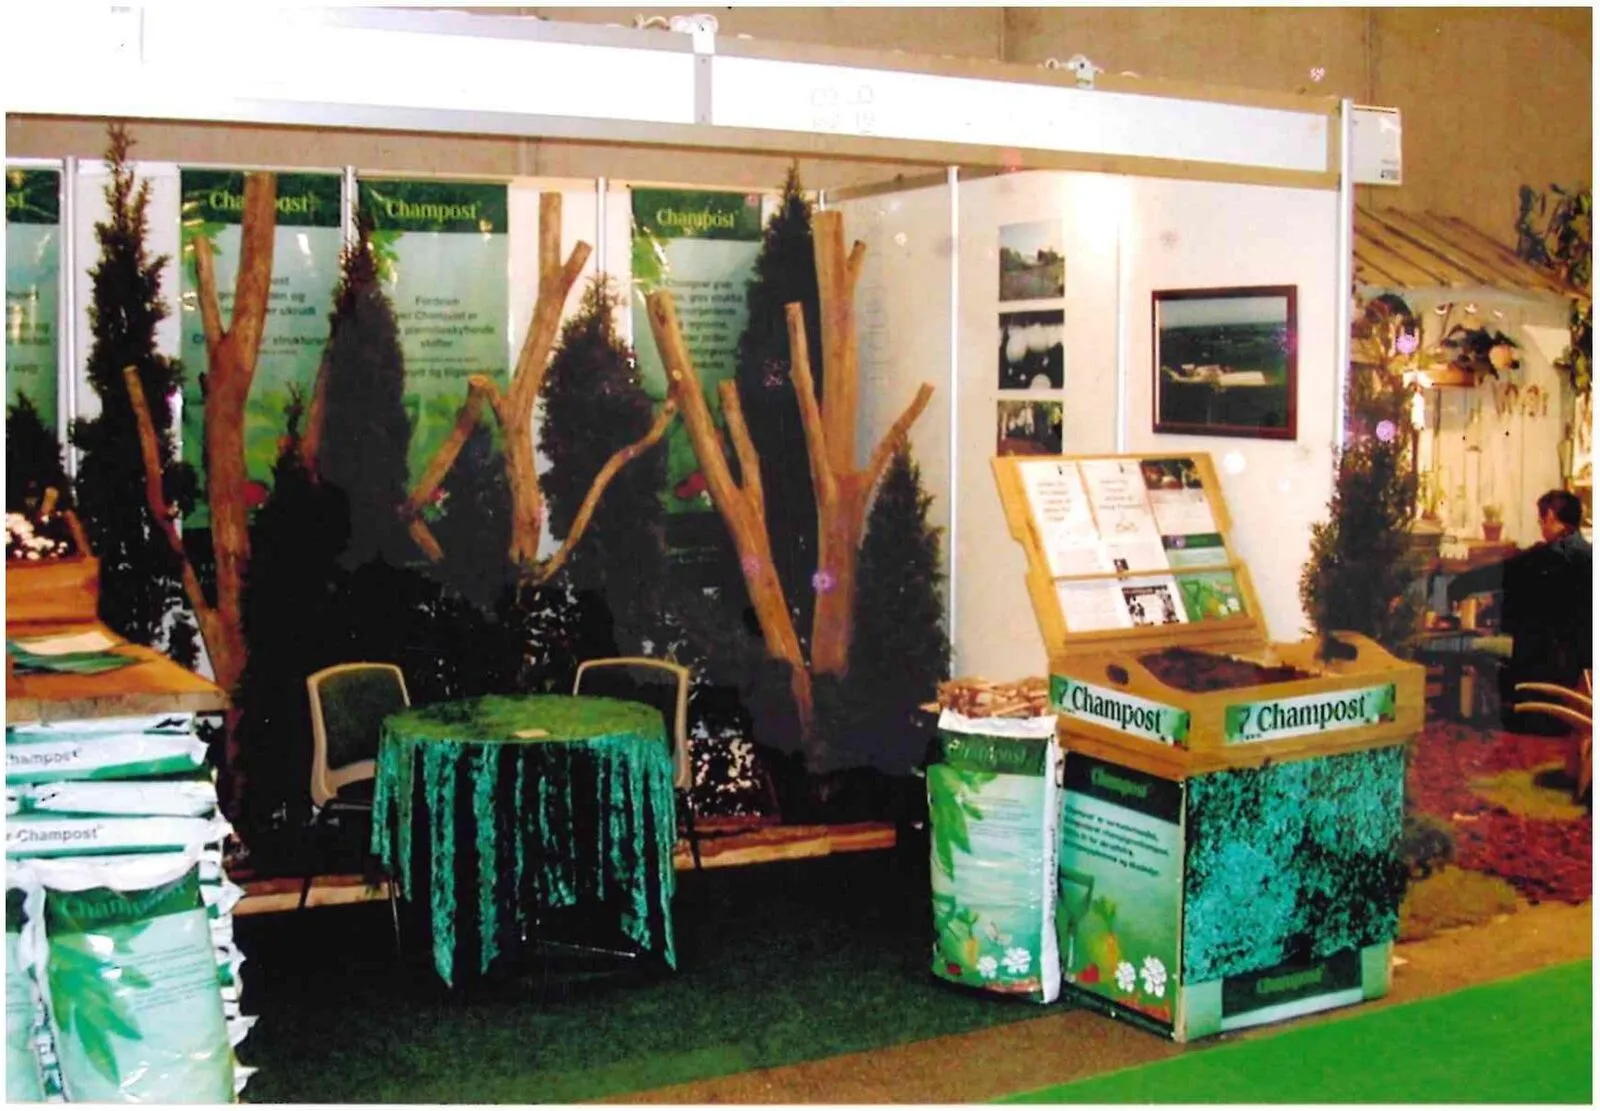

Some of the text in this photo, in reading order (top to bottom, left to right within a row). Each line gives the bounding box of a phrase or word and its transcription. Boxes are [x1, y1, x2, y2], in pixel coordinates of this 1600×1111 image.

[208, 190, 311, 213] Chaost
[386, 203, 477, 221] Champost
[656, 209, 736, 230] Champost
[1072, 686, 1162, 733] Champost
[1257, 695, 1367, 733] Champost
[19, 826, 98, 844] Champost
